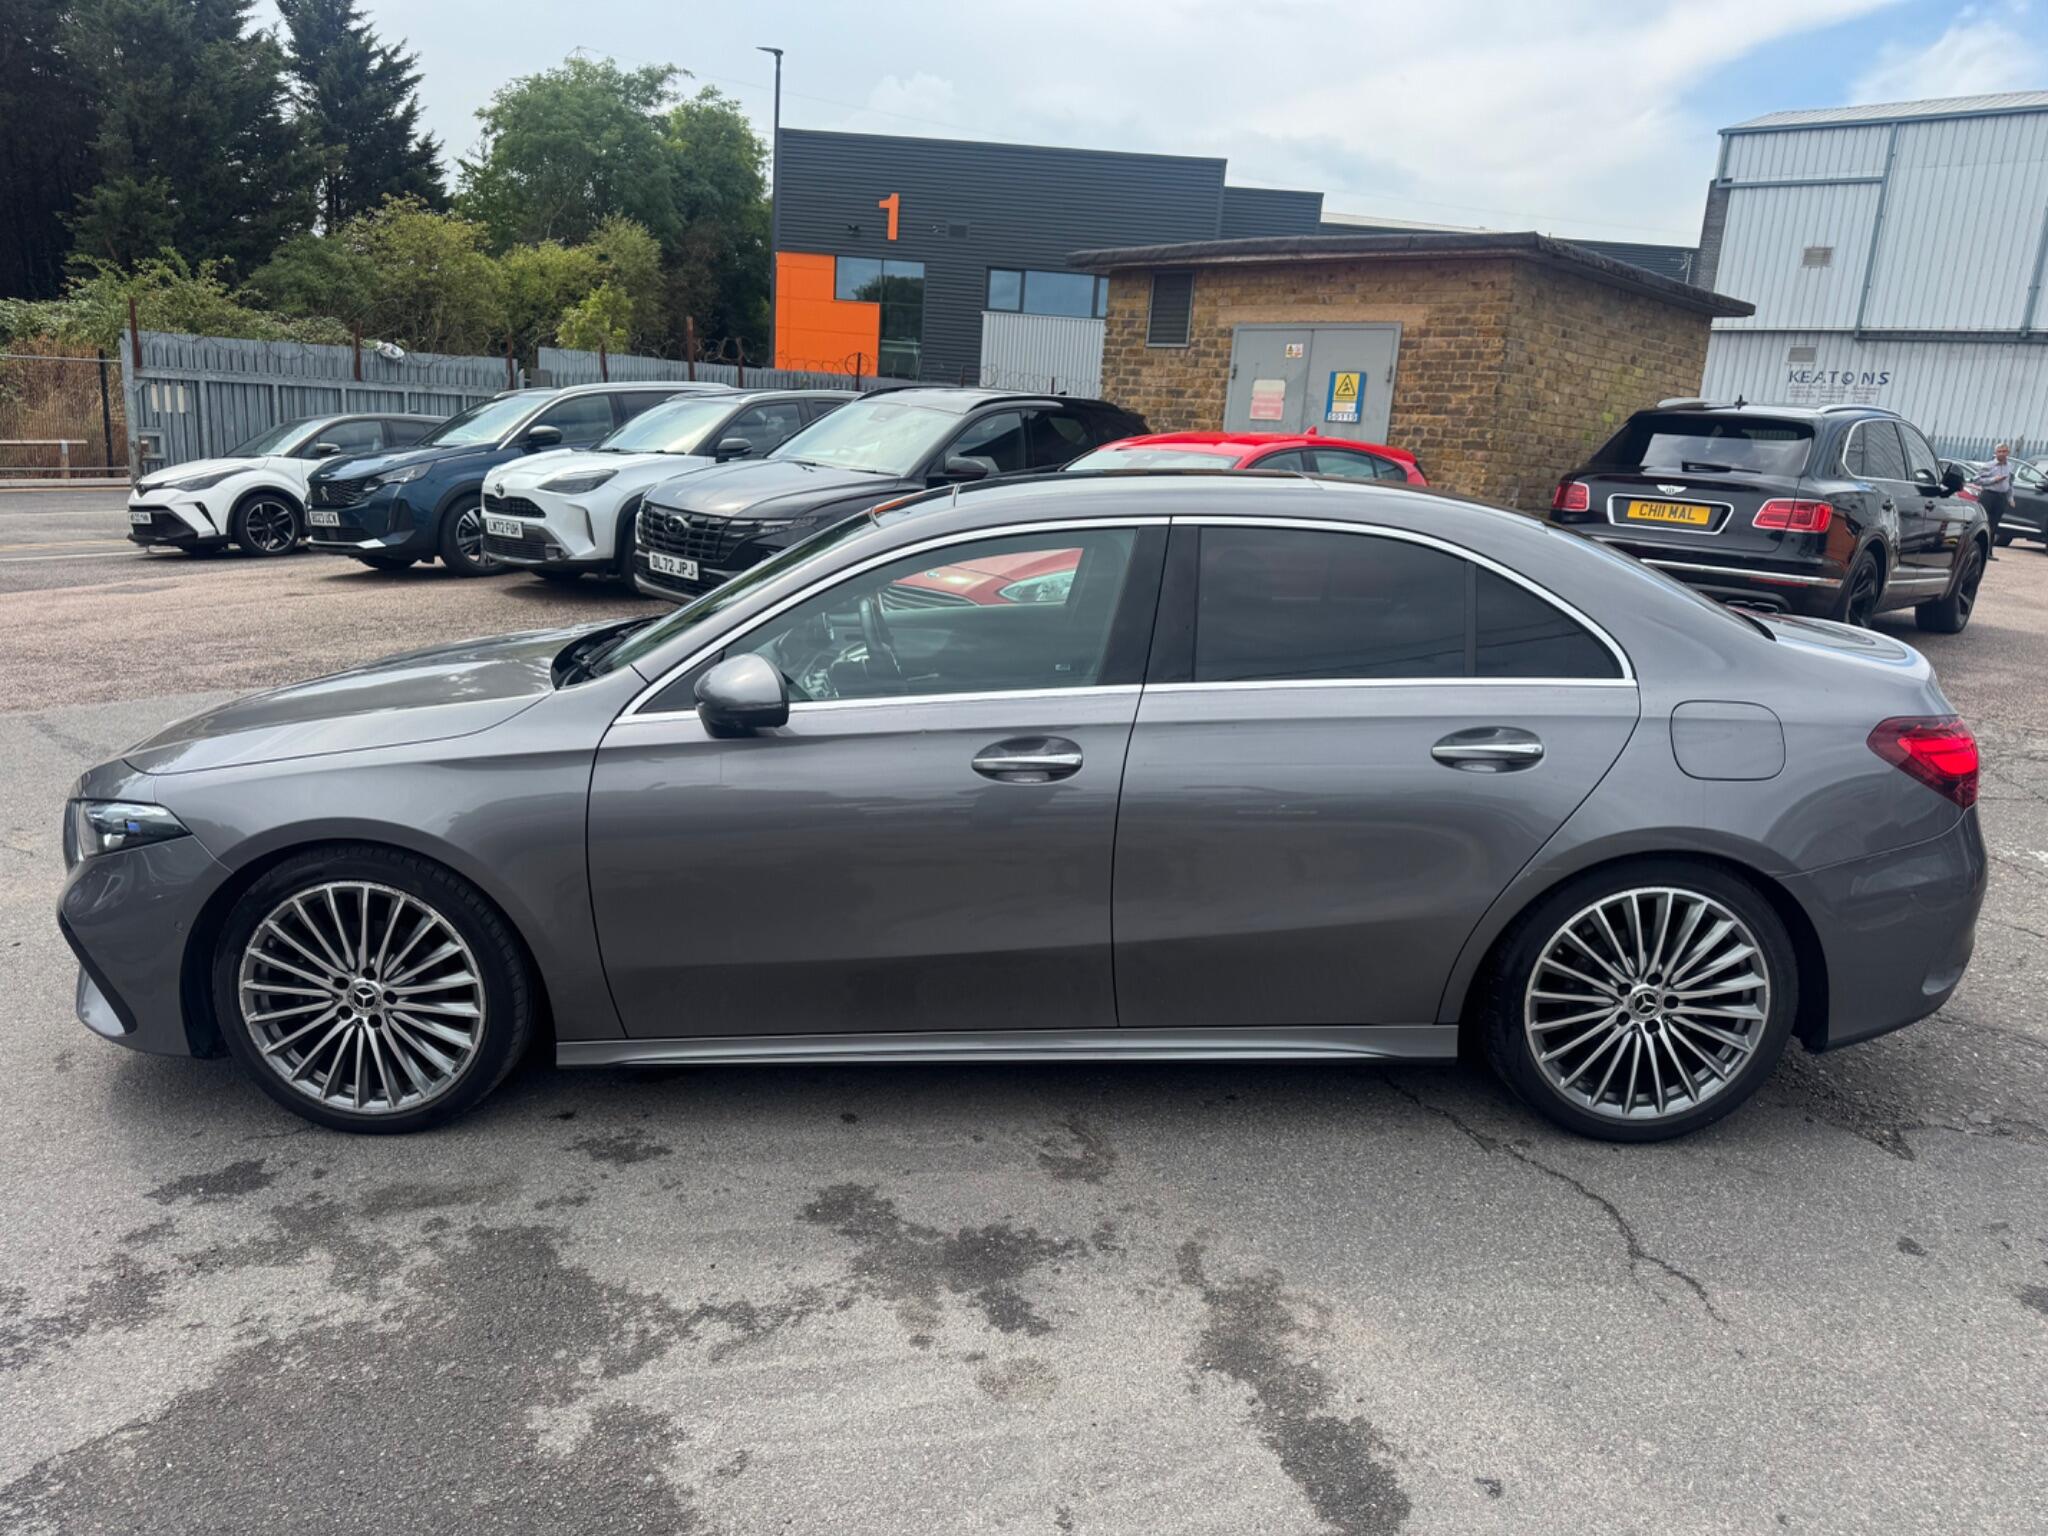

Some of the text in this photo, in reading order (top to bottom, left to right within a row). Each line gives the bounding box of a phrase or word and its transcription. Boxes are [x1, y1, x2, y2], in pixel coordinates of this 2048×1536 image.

[878, 192, 899, 240] 1
[1789, 371, 1890, 385] KEATONS
[1667, 505, 1696, 520] MAL
[676, 561, 695, 577] JPJ
